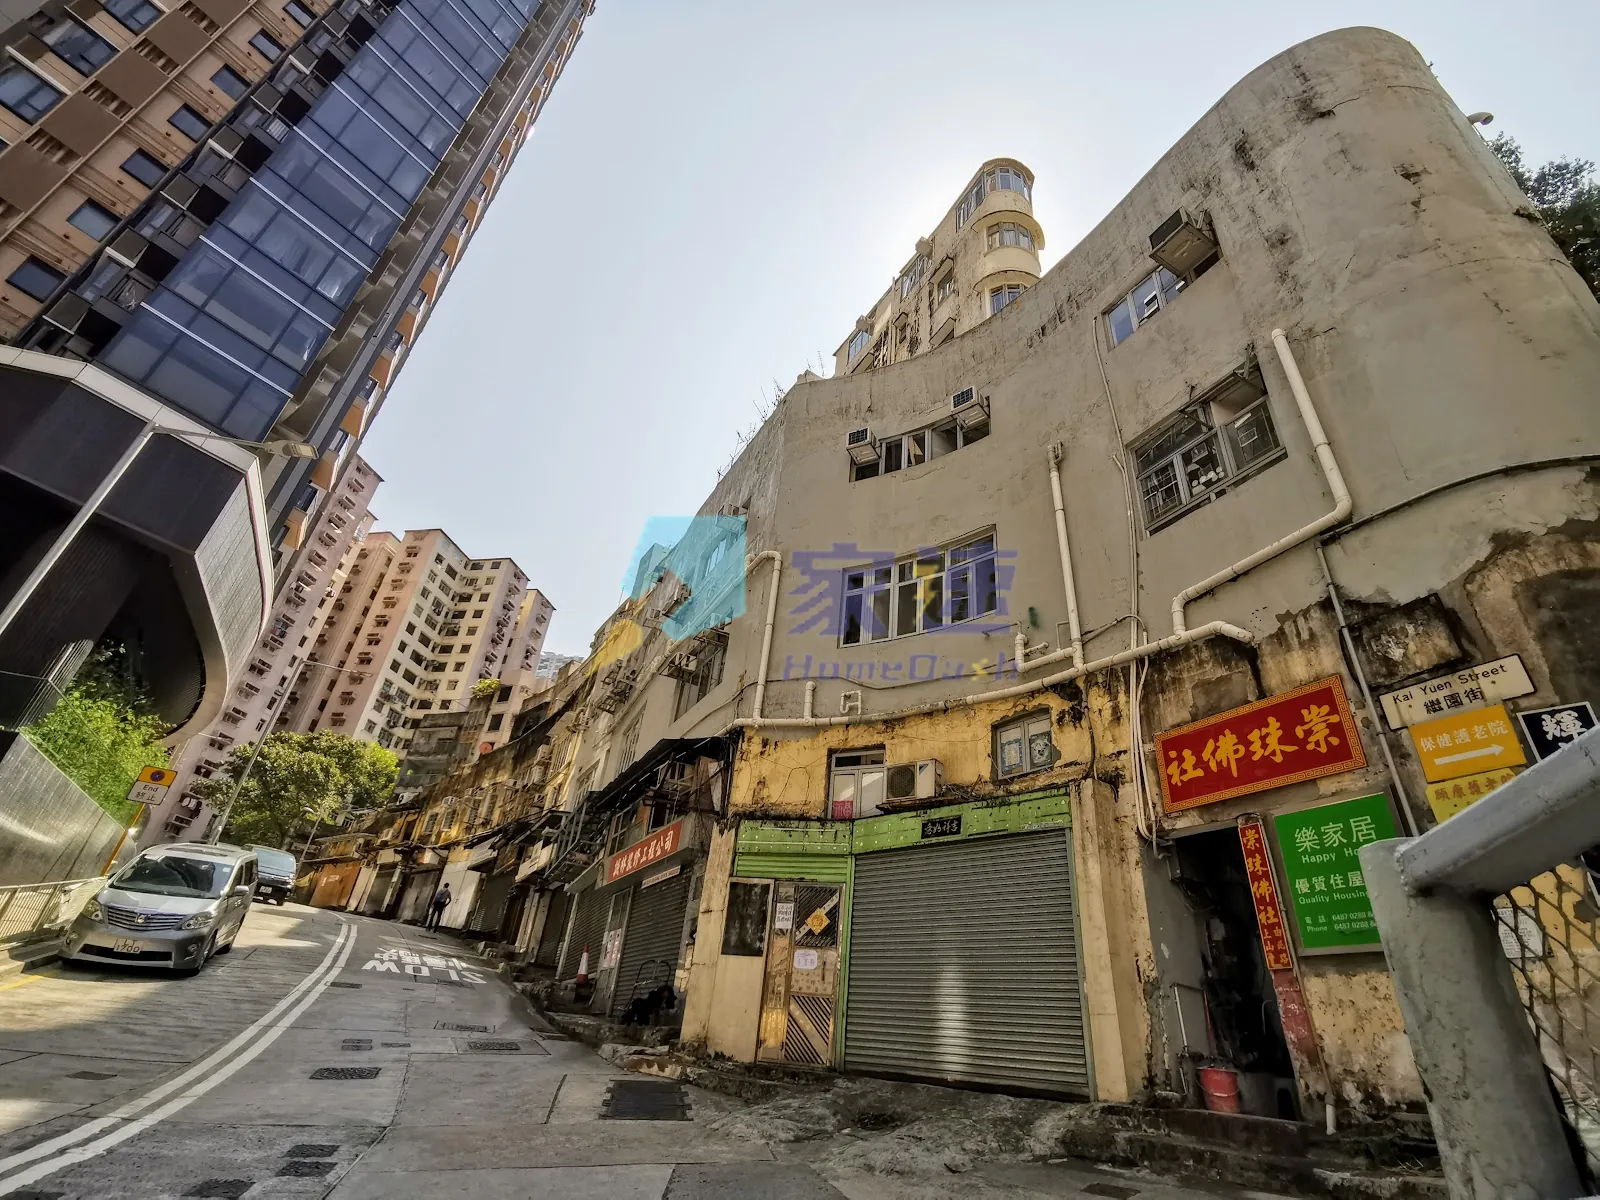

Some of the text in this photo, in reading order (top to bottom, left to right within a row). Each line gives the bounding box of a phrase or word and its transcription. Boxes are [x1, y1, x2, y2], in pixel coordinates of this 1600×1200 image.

[1392, 663, 1508, 704] Kai Yuen Street
[1424, 686, 1485, 715] 繼園街
[1420, 719, 1509, 752] 保健護老院
[135, 791, 156, 802] 終止
[142, 784, 160, 793] End
[1294, 815, 1377, 852] 樂家居
[1301, 847, 1359, 864] Happy Ho
[1243, 829, 1279, 926] 崇珠佛社
[1298, 889, 1368, 905] Quality Housin
[361, 959, 487, 984] SLOW
